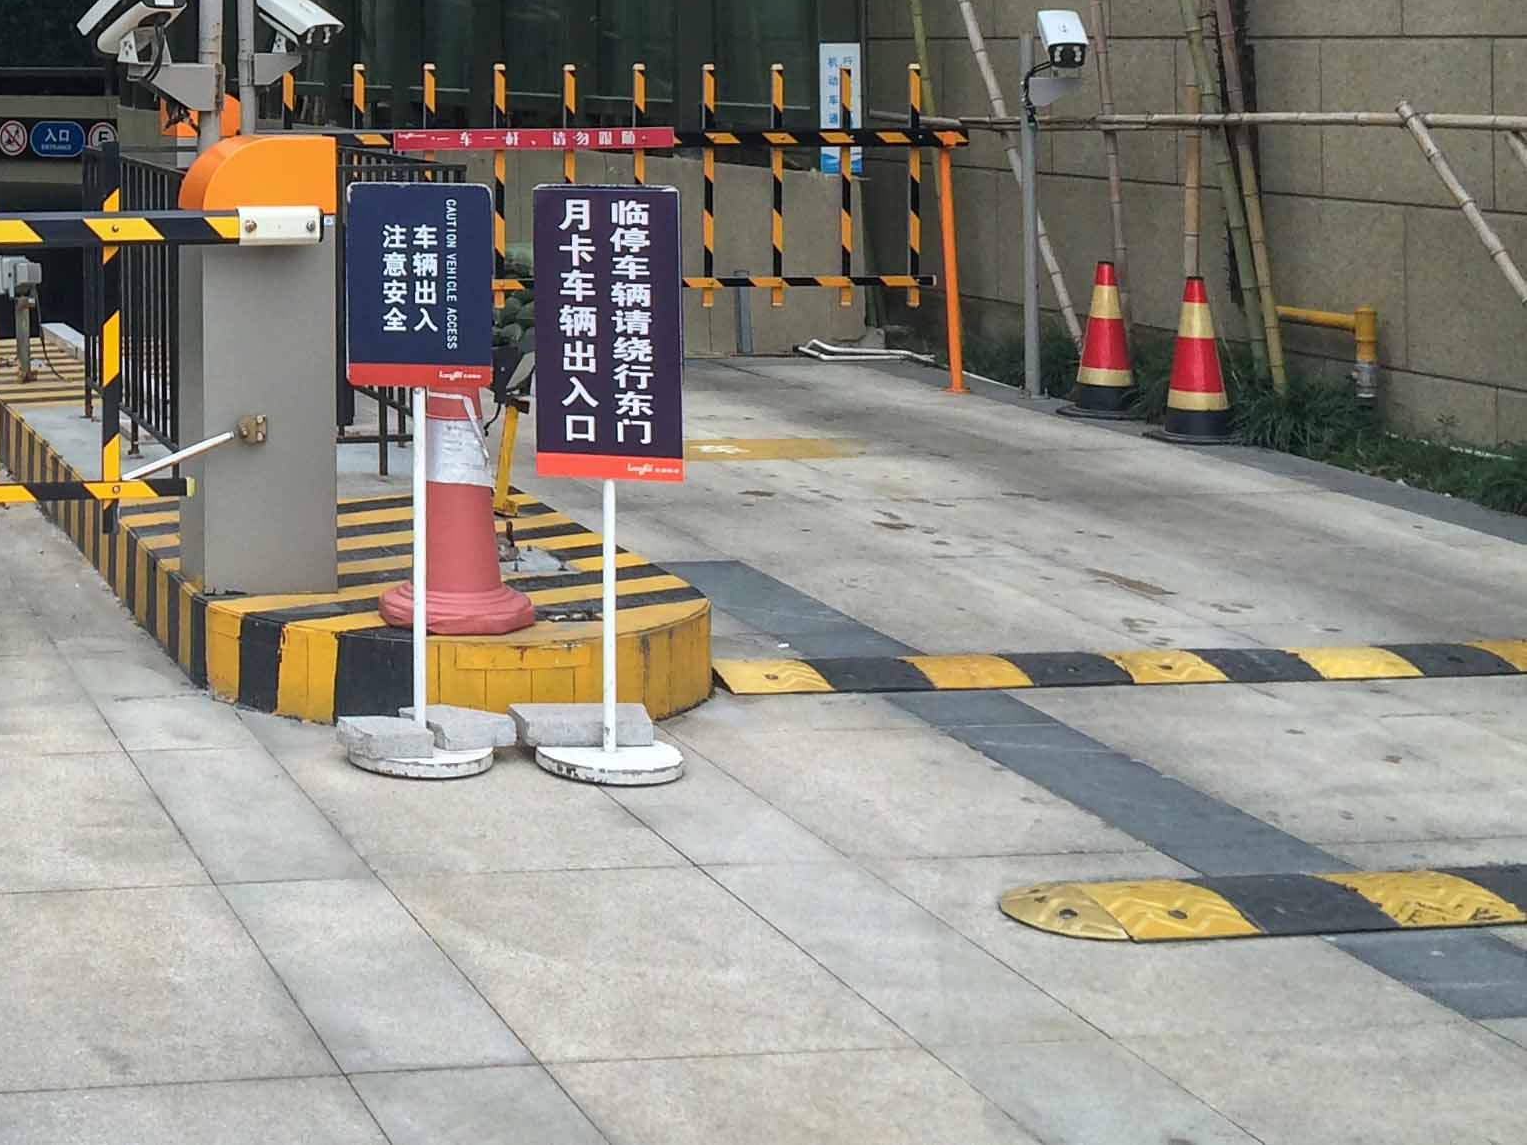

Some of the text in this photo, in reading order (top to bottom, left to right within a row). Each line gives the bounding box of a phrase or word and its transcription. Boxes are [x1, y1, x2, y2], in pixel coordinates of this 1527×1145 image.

[45, 128, 70, 142] 入口
[382, 224, 408, 333] 注意安全
[413, 224, 439, 333] 车辆出入
[445, 198, 458, 350] CAUTION VEHICLE ACCESS
[558, 198, 600, 442] 月卡车辆出入口
[610, 199, 654, 445] 临停车辆请绕行东门
